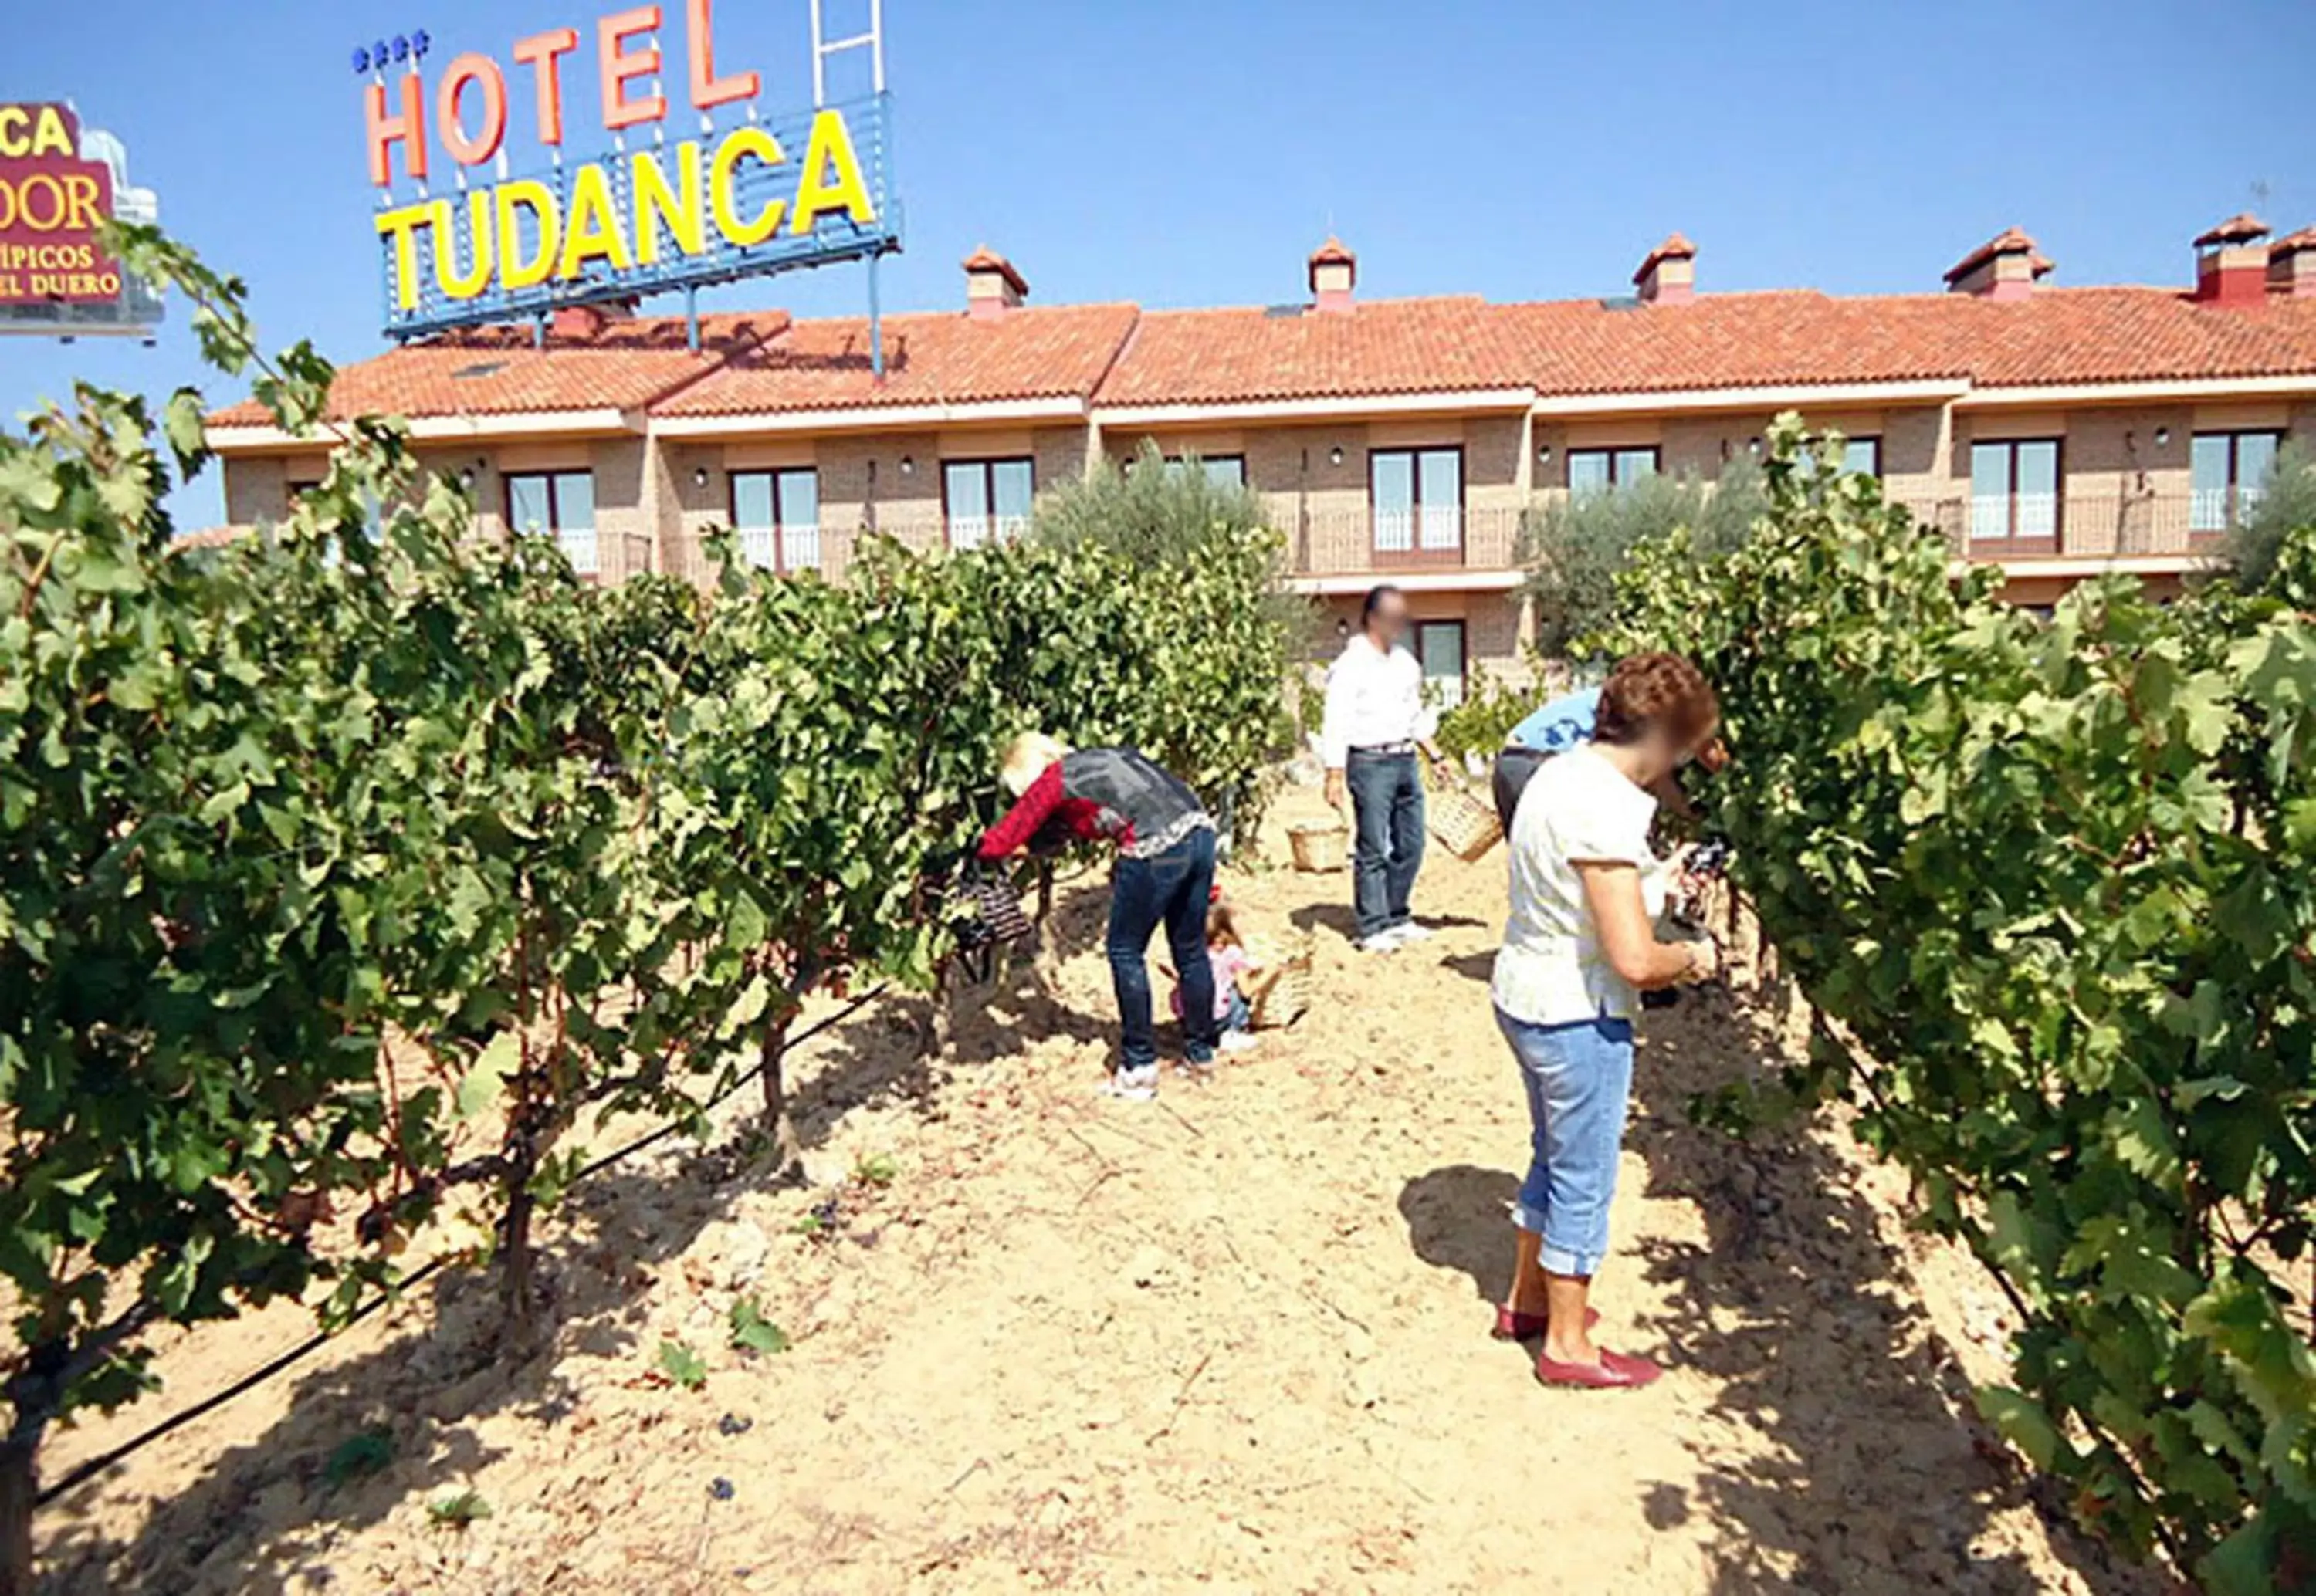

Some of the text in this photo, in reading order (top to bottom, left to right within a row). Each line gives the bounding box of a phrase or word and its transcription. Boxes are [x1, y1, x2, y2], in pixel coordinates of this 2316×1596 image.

[0, 107, 73, 157] CA
[364, 0, 760, 186] HOTEL
[375, 110, 875, 309] TUDANCA
[30, 272, 120, 296] DUERO
